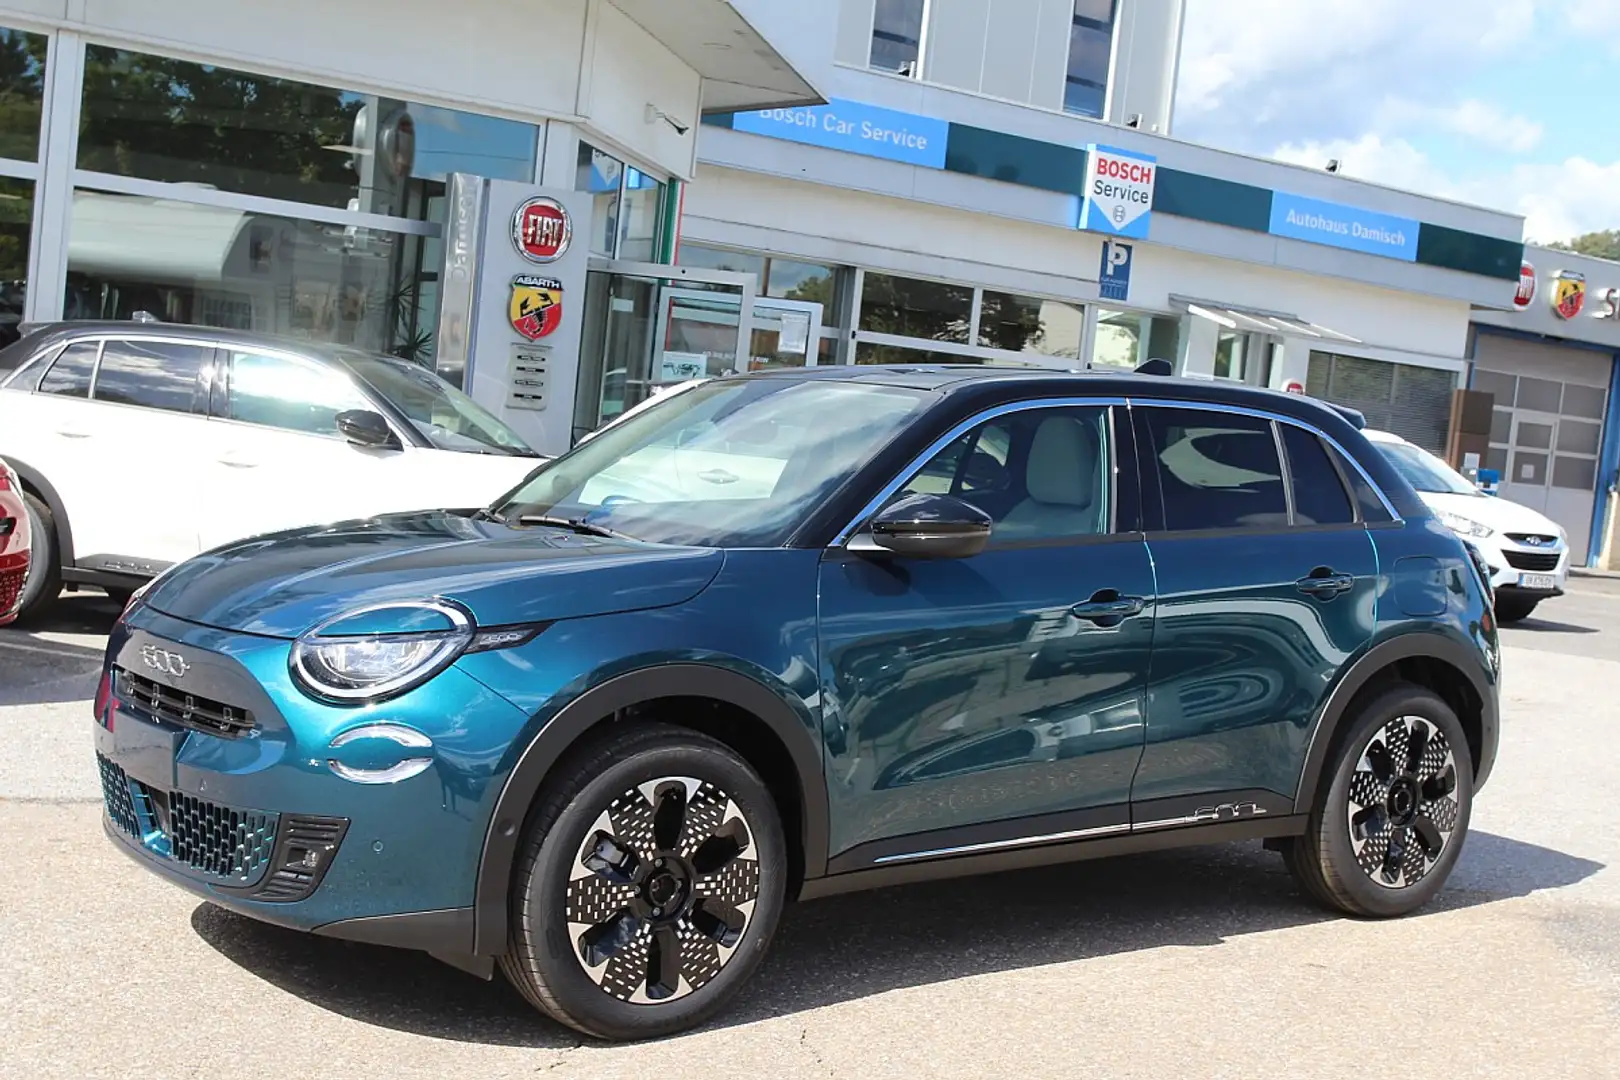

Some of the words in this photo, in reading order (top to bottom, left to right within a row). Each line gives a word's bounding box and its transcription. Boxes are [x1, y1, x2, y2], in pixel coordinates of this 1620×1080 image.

[823, 113, 856, 135] Car
[861, 121, 928, 150] Service
[1097, 157, 1152, 185] BOSCH
[1093, 179, 1149, 204] Service
[526, 213, 563, 247] FIAT
[1285, 208, 1349, 236] Autohaus
[1351, 221, 1406, 247] Damisch
[516, 276, 561, 289] ABARTH
